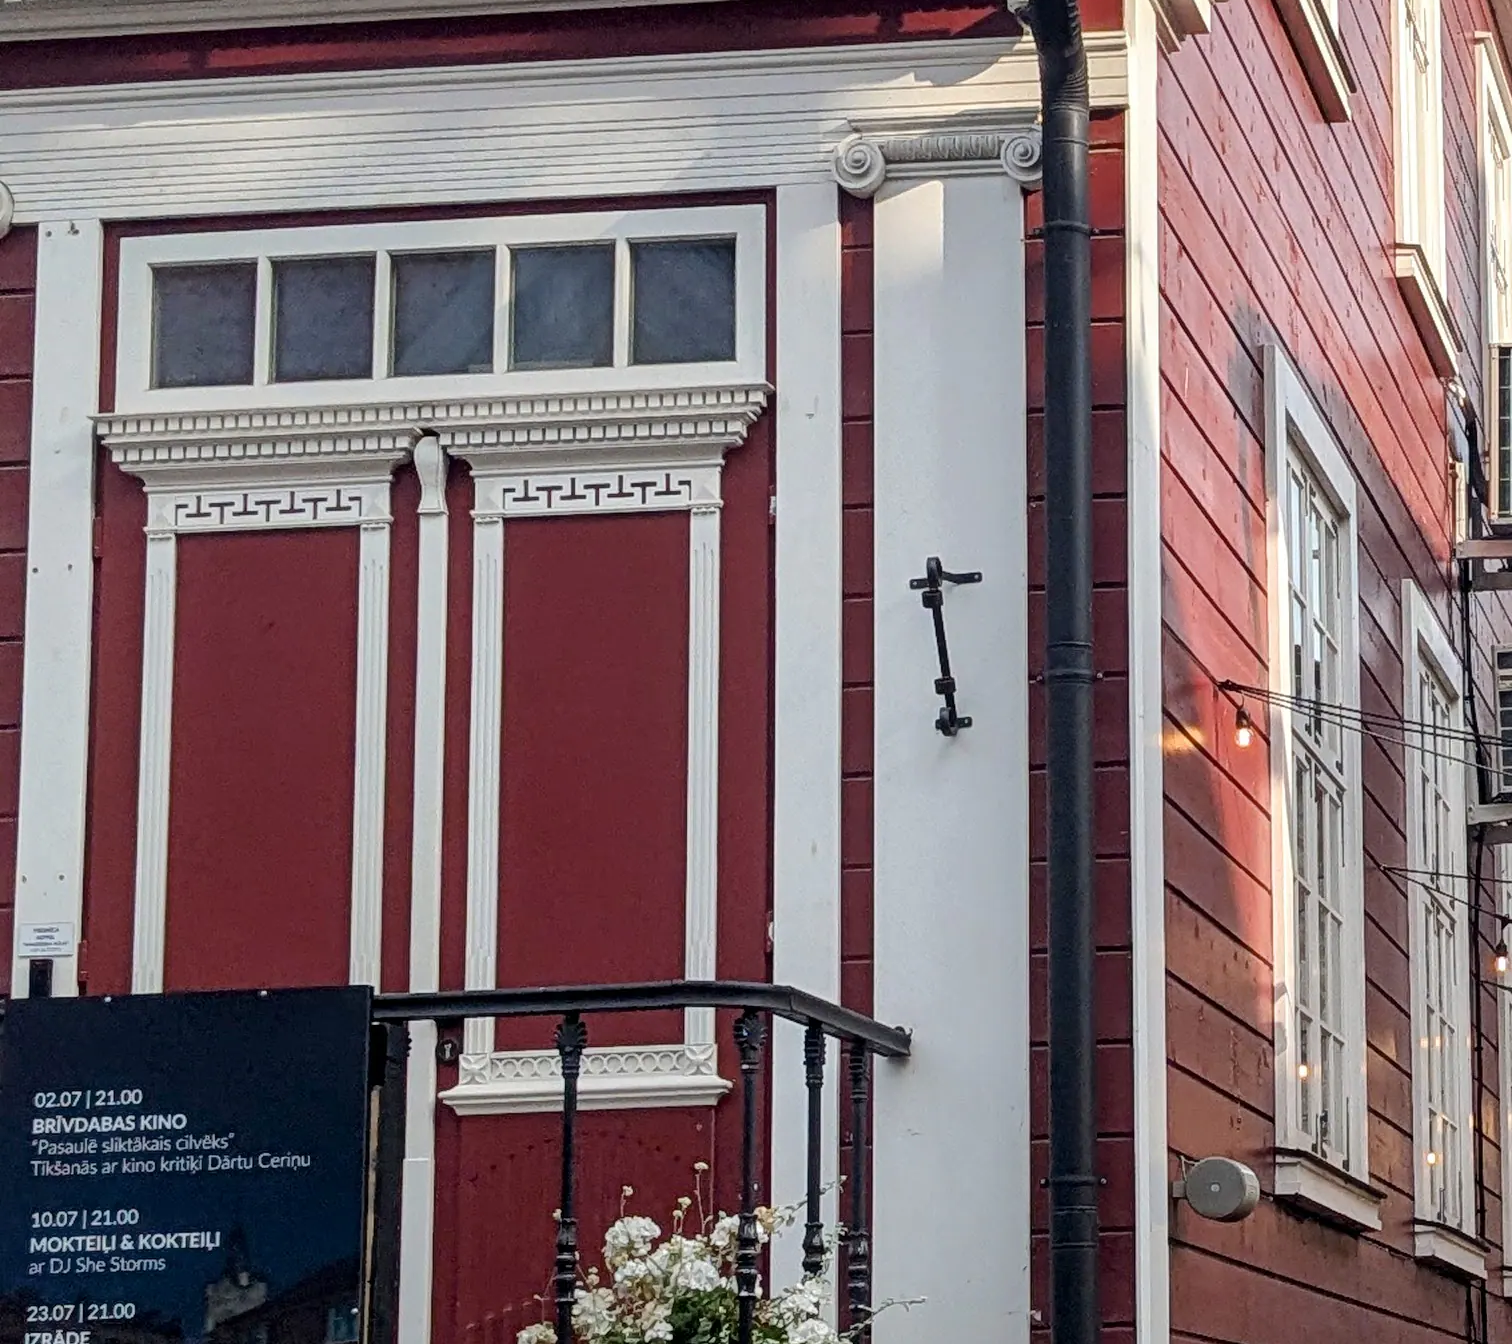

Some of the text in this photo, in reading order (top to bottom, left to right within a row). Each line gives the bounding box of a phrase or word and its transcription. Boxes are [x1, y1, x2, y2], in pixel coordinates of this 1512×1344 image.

[34, 1091, 80, 1109] 02.07
[96, 1089, 143, 1107] 21.00
[32, 1113, 188, 1134] BRĪVDABAS KINO
[102, 1136, 171, 1153] sliktākais
[31, 1151, 311, 1177] Tikšanās ar kino kritiķi Dārtu Ceriņu
[32, 1210, 78, 1228] 10.07
[91, 1208, 139, 1226] 21.00
[29, 1231, 221, 1254] MOKTEIĻI & KOKTEIĻI
[29, 1256, 166, 1275] ar DJ She Storms
[27, 1304, 74, 1322] 23.07
[87, 1303, 136, 1321] 21.00
